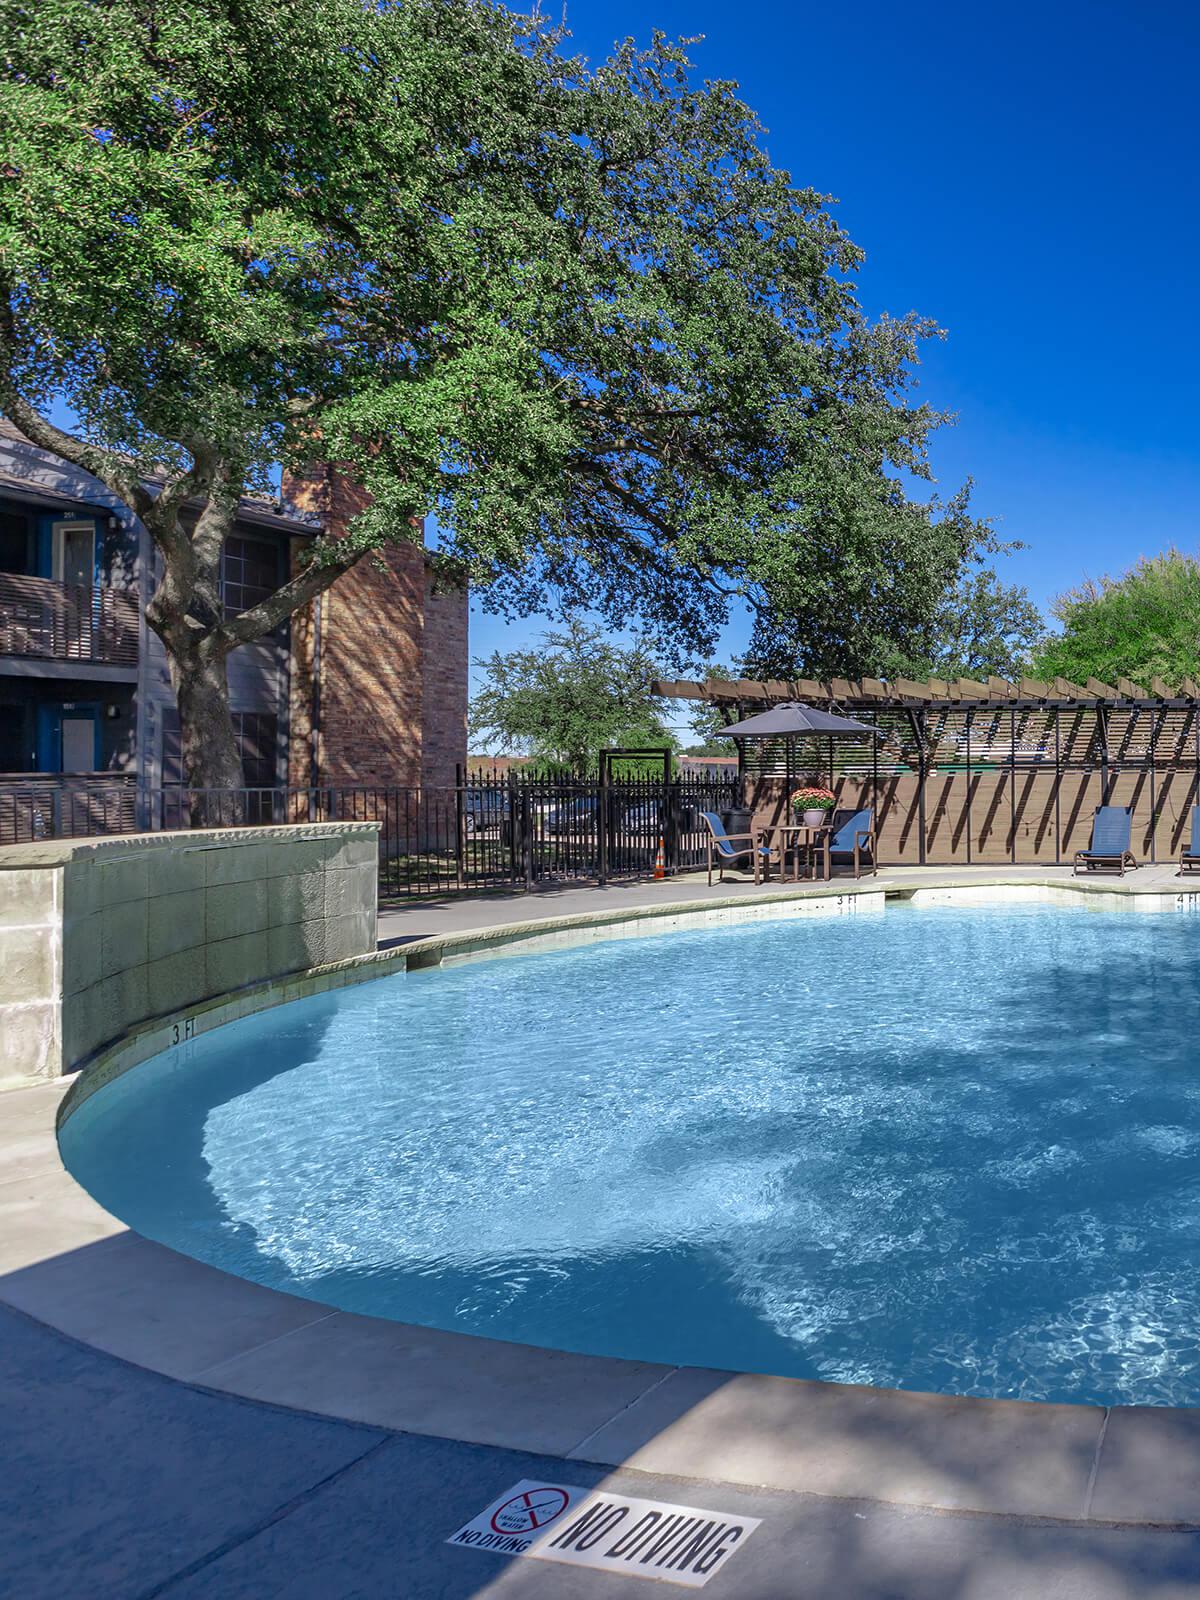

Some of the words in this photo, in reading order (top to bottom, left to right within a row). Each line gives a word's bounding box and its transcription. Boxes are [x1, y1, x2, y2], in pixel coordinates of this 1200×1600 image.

[836, 894, 843, 905] 3
[1177, 893, 1184, 903] 4
[172, 1024, 180, 1045] 3
[185, 1017, 196, 1040] FT
[498, 1513, 529, 1524] SHALLOW
[501, 1521, 525, 1529] WATER
[454, 1529, 482, 1544] NO
[477, 1532, 533, 1553] DIVING
[548, 1501, 630, 1552] NO
[604, 1510, 744, 1575] DIVING
